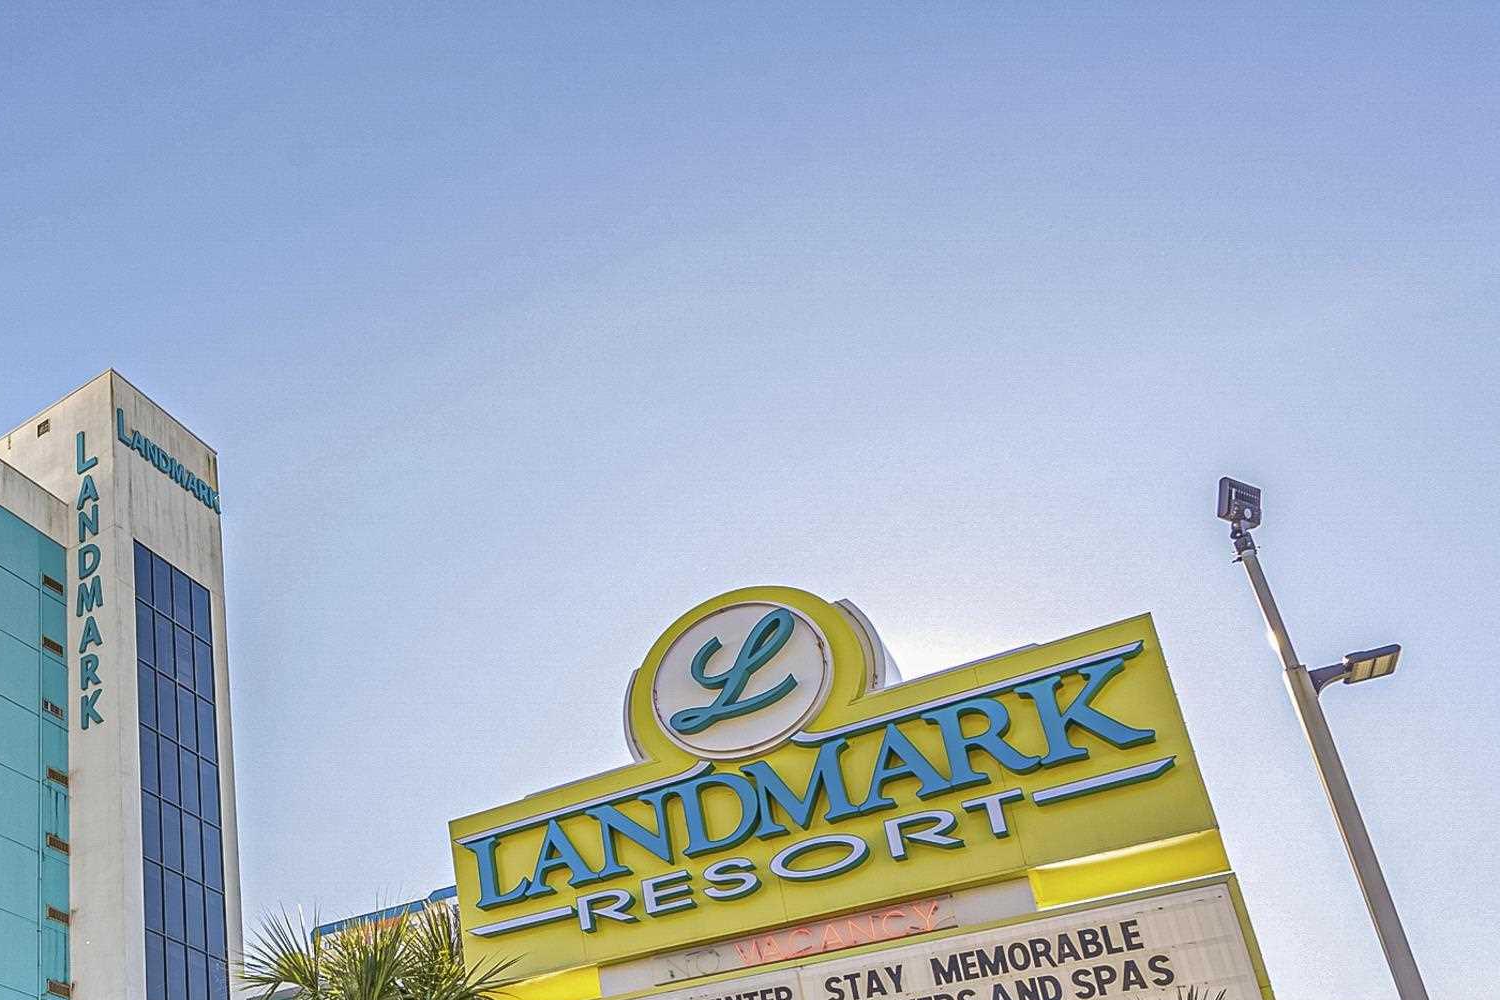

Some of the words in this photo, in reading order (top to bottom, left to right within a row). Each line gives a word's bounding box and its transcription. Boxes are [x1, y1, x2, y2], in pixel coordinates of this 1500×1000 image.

[117, 408, 221, 515] LANDMARK
[75, 431, 104, 730] LANDMARK
[467, 656, 1156, 911] LANDMARK
[577, 788, 1025, 933] RESORT
[734, 901, 938, 964] VACANCY
[930, 919, 1145, 987] MEMORABLE
[1071, 955, 1175, 1000] SPAS
